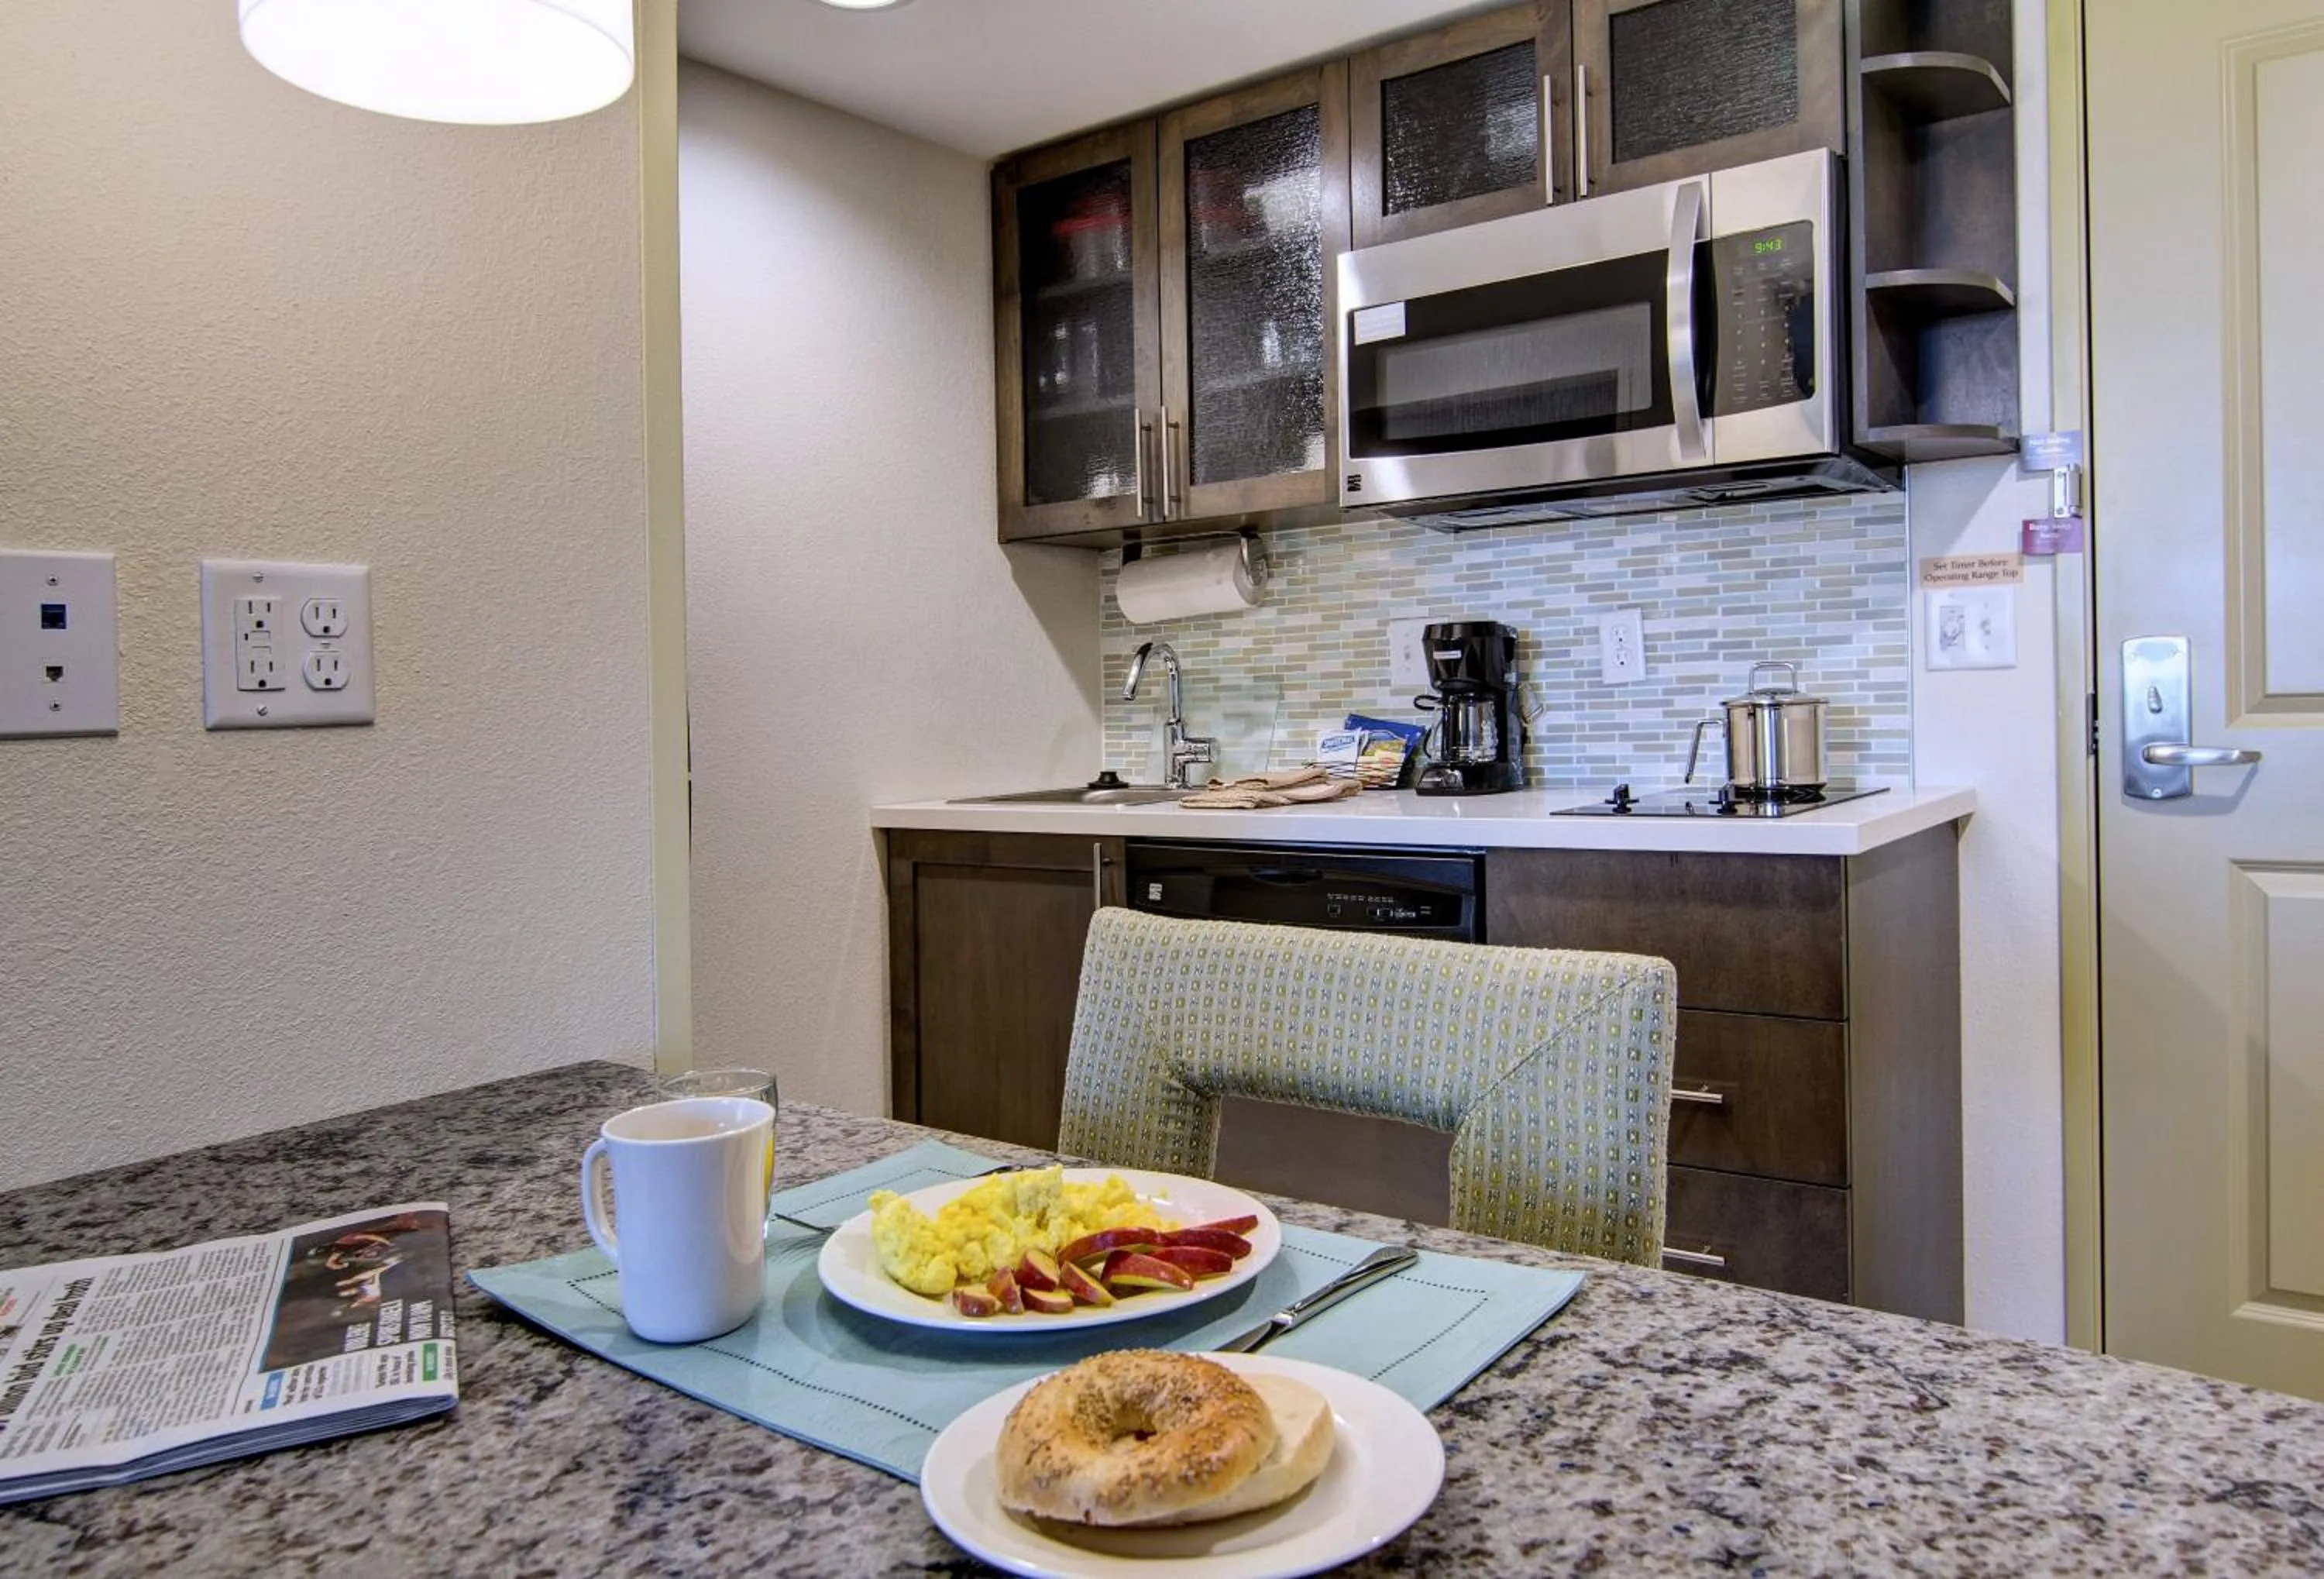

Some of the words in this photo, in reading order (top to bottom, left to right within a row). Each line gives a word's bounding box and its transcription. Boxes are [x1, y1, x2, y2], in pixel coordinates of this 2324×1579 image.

[1755, 239, 1783, 253] 9:43
[1934, 562, 1948, 571] Set
[1951, 561, 1975, 569] Timer
[1978, 559, 2009, 568] Before
[1923, 573, 1969, 583] Operating
[1972, 571, 1999, 580] Range
[2001, 569, 2019, 578] Top
